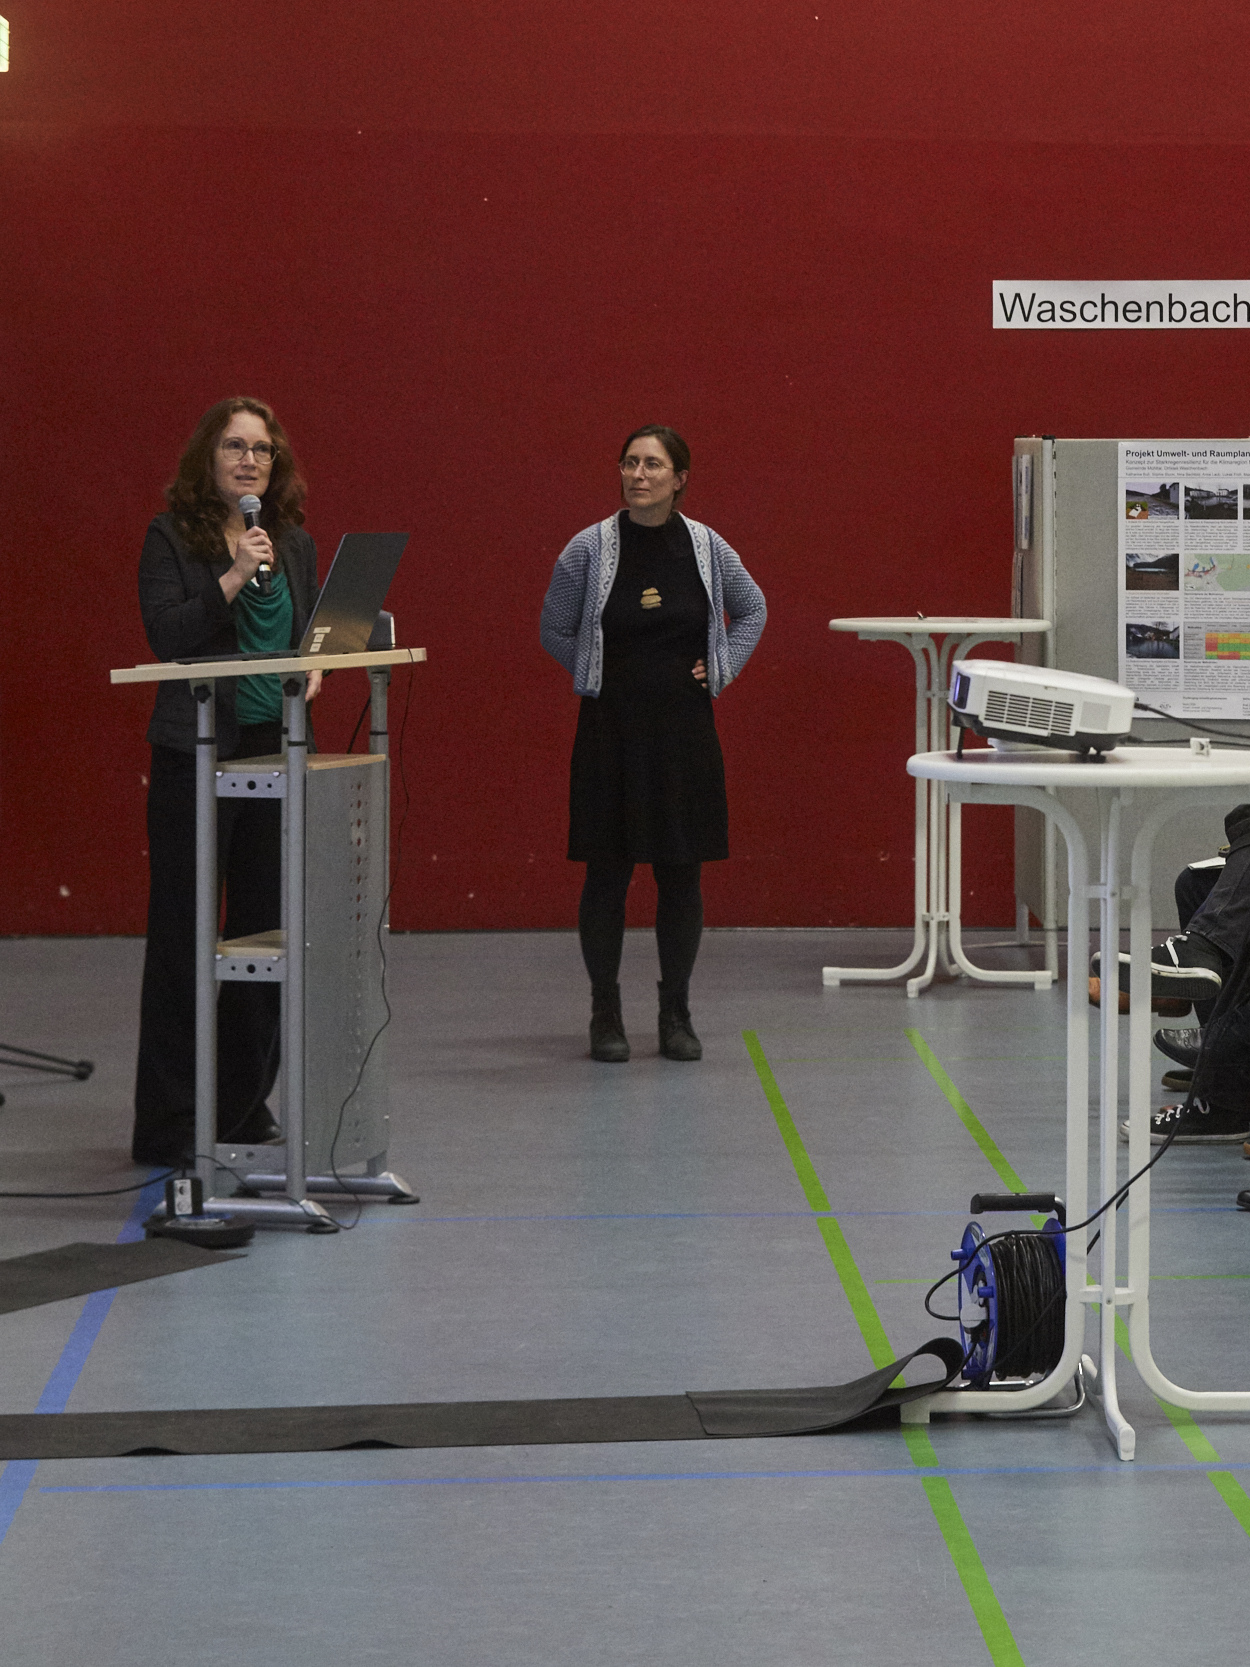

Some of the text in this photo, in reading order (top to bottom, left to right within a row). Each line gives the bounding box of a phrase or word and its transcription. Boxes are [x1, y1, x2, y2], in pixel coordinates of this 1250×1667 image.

[1126, 450, 1155, 459] Projekt
[1157, 450, 1190, 458] Umwelt-
[1192, 450, 1208, 458] und
